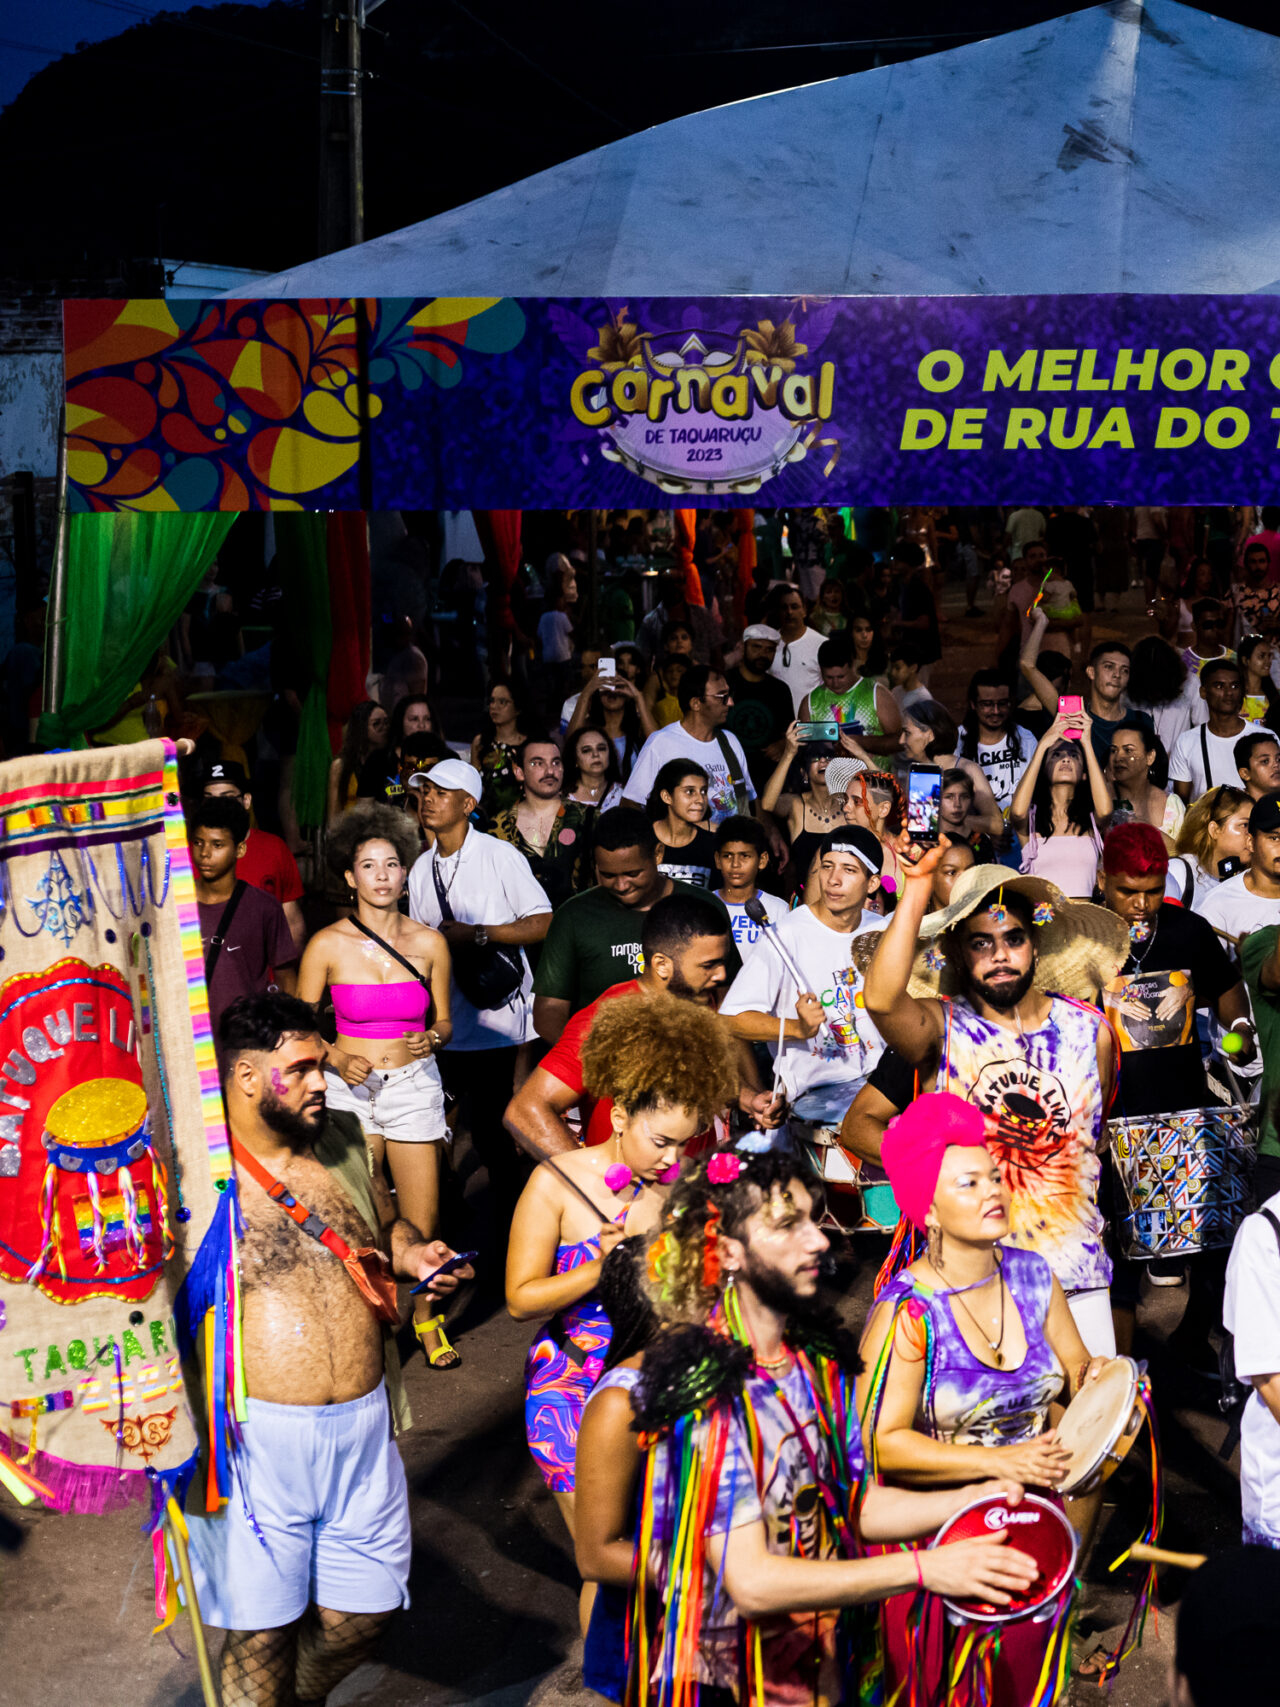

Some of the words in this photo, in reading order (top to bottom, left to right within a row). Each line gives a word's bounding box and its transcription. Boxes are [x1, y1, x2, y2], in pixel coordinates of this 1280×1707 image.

[917, 349, 964, 393] O
[982, 348, 1250, 392] MELHOR
[570, 361, 835, 426] Carnaval
[645, 430, 664, 444] DE
[669, 426, 762, 446] TAQUARUÇU
[900, 407, 988, 450] DE
[1003, 407, 1135, 450] RUA
[1154, 406, 1250, 450] DO
[686, 448, 723, 462] 2023
